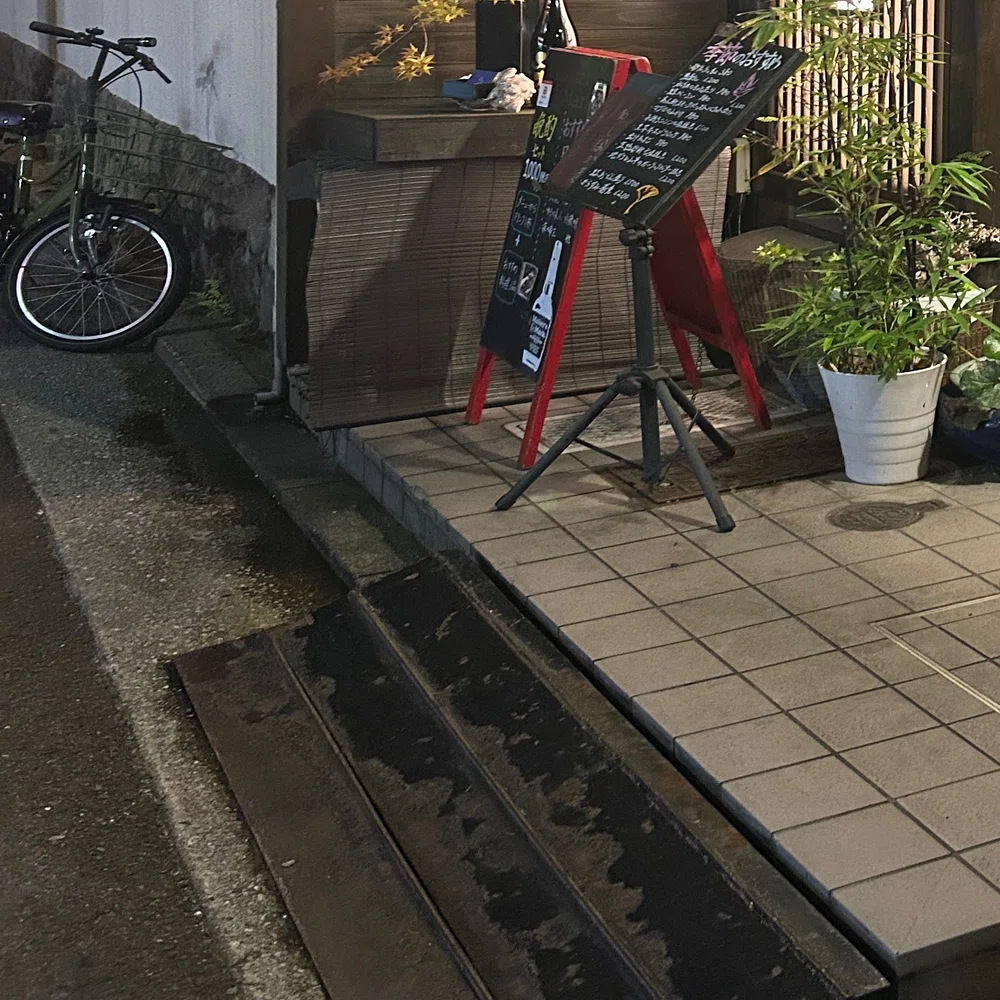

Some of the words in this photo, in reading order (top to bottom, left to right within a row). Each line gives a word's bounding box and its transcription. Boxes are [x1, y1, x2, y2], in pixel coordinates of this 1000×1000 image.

[702, 41, 783, 71] 季節のおすすめ
